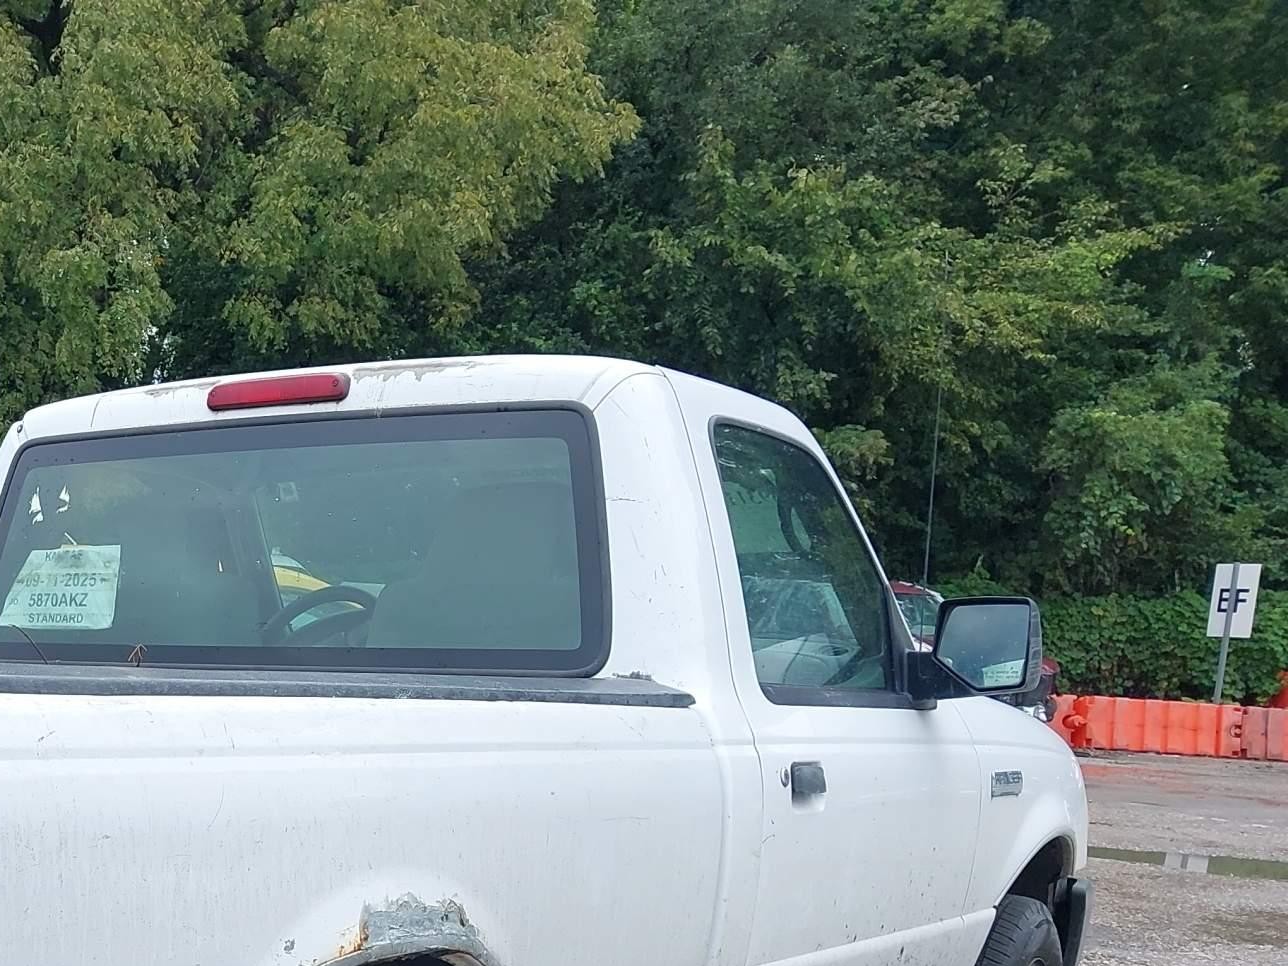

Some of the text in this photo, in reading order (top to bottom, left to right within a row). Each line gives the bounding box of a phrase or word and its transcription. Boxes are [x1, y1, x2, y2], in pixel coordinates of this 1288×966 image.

[28, 592, 89, 608] 5870AKZ
[1217, 588, 1250, 613] EF
[28, 612, 84, 624] STANDARD
